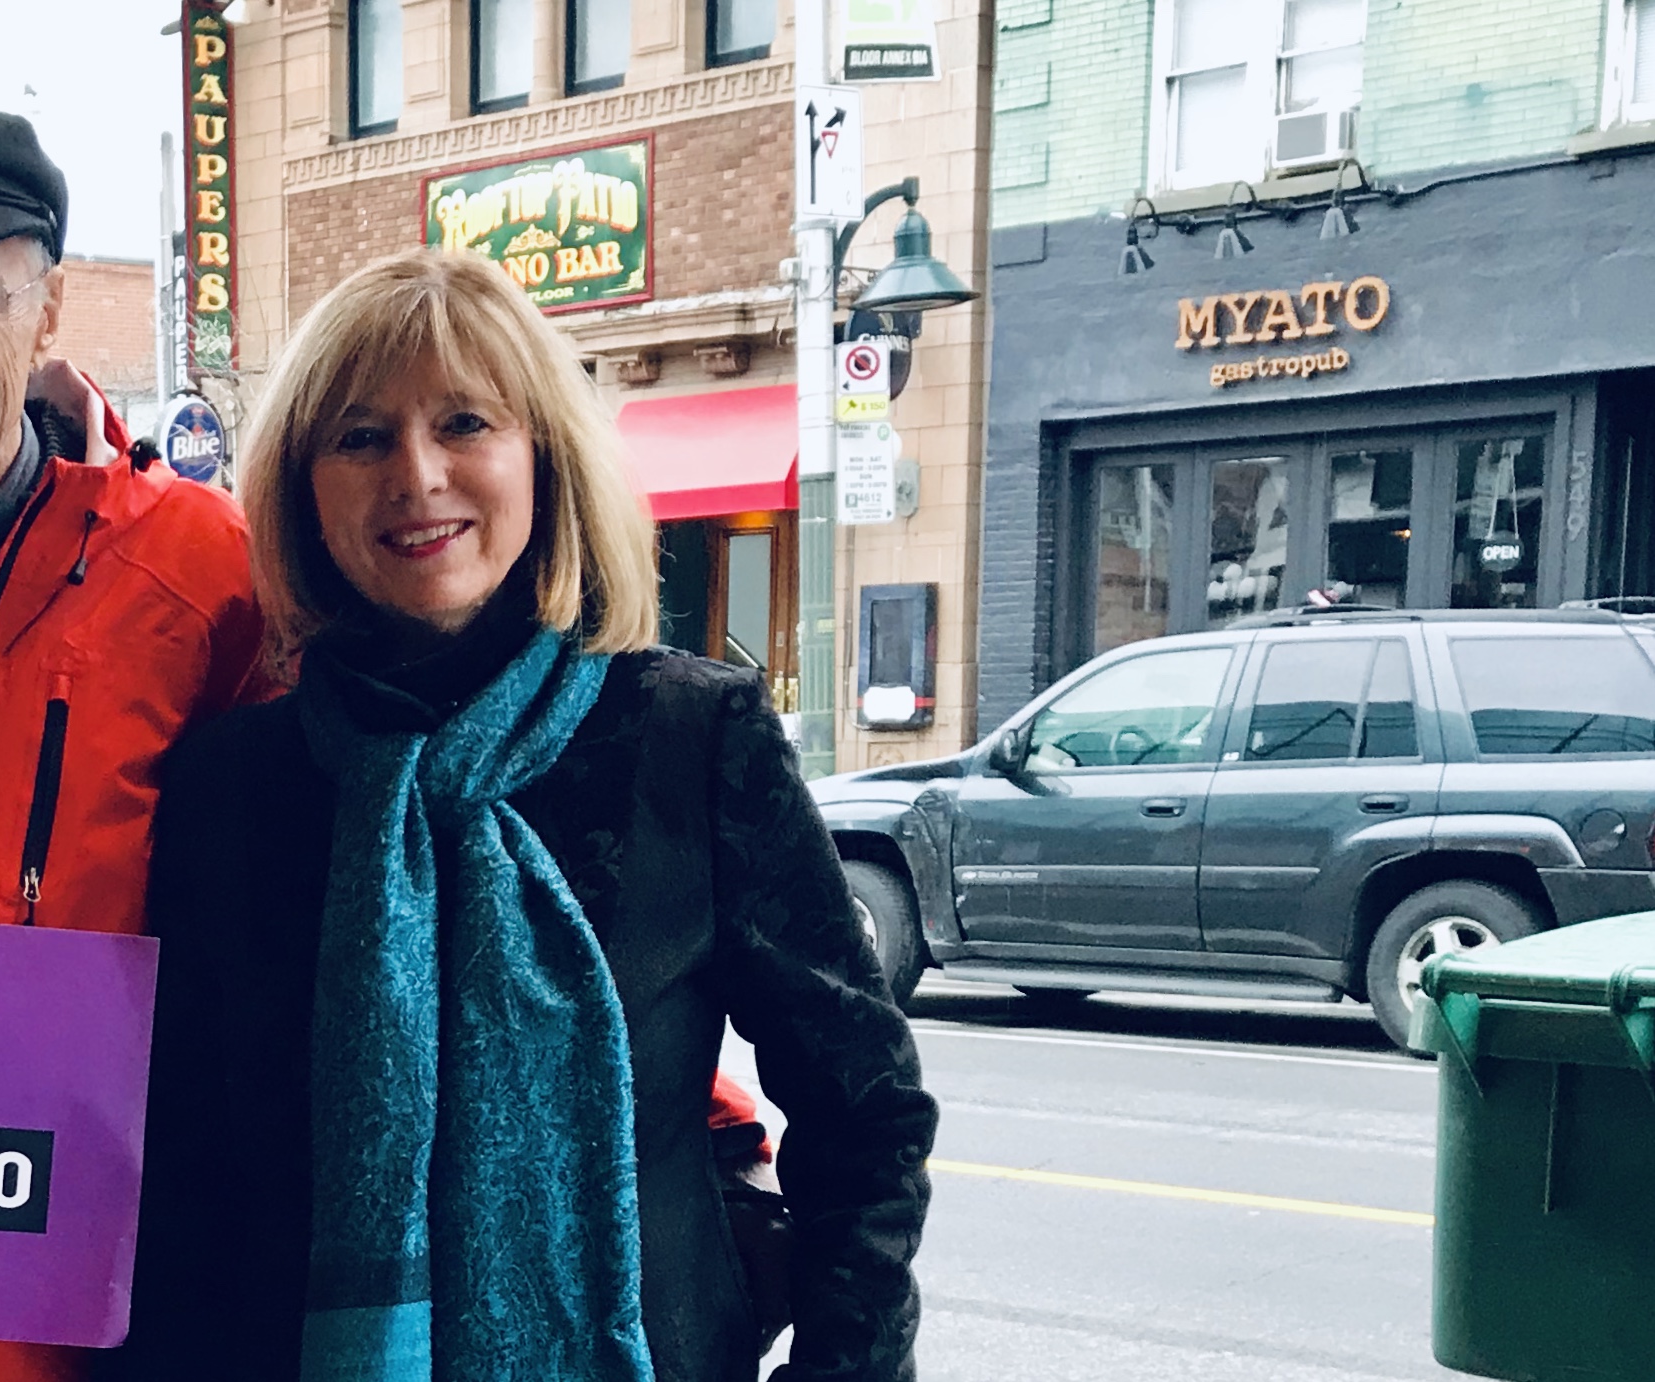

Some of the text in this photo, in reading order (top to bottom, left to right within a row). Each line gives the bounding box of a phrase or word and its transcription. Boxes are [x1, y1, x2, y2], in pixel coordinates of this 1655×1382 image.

[849, 50, 881, 66] BLOOR
[882, 50, 912, 65] ANNEX
[194, 33, 230, 314] PAUPERS
[436, 158, 638, 255] ROOFTOP PATIO
[555, 241, 624, 283] BAR
[174, 254, 188, 396] PAUPER
[1175, 275, 1390, 348] MYATO
[1210, 347, 1349, 388] gastropub
[172, 436, 221, 461] Blue
[1483, 546, 1520, 560] OPEN
